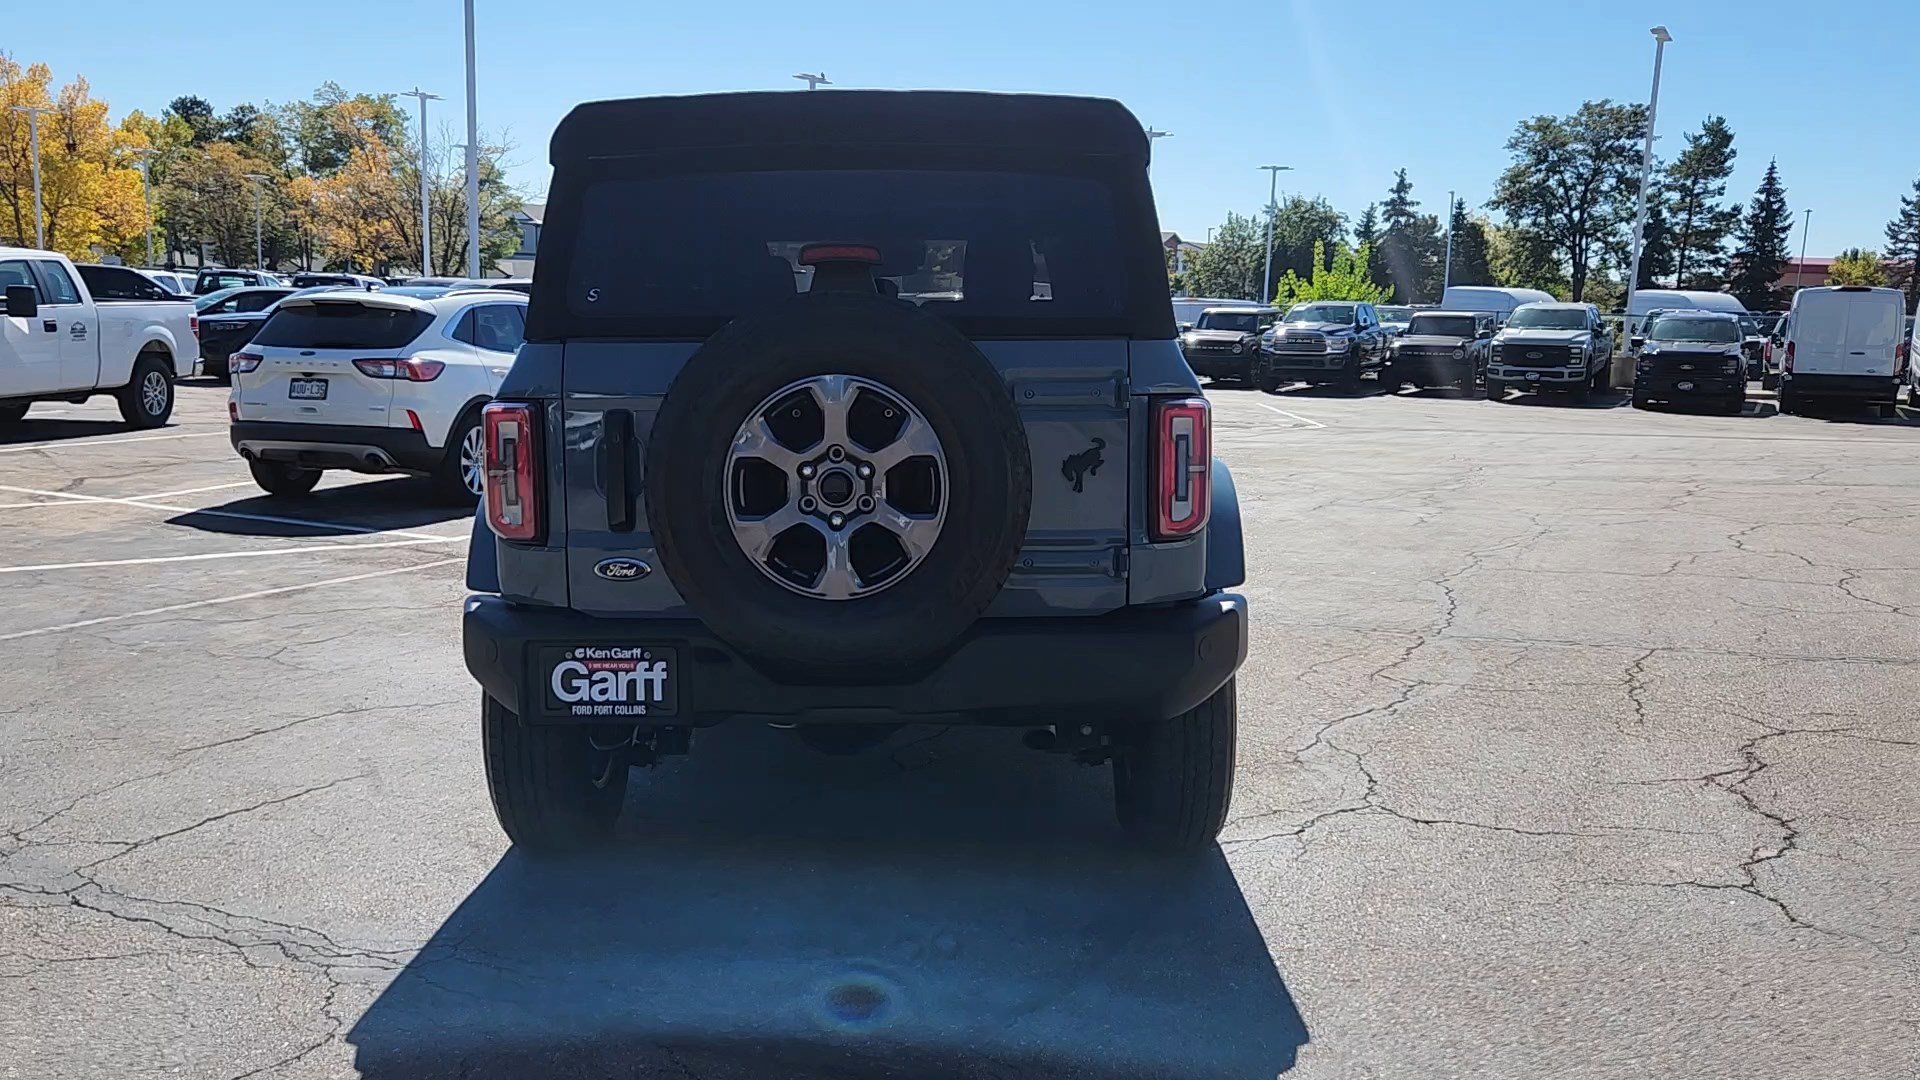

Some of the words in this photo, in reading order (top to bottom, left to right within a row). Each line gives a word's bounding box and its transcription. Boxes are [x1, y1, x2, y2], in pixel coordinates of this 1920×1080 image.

[606, 563, 637, 576] Ford
[586, 647, 610, 659] Ken
[611, 647, 641, 659] Garff
[551, 660, 667, 702] Garff
[572, 705, 592, 715] FORD
[593, 705, 613, 715] FORT
[614, 705, 646, 715] COLLINS
